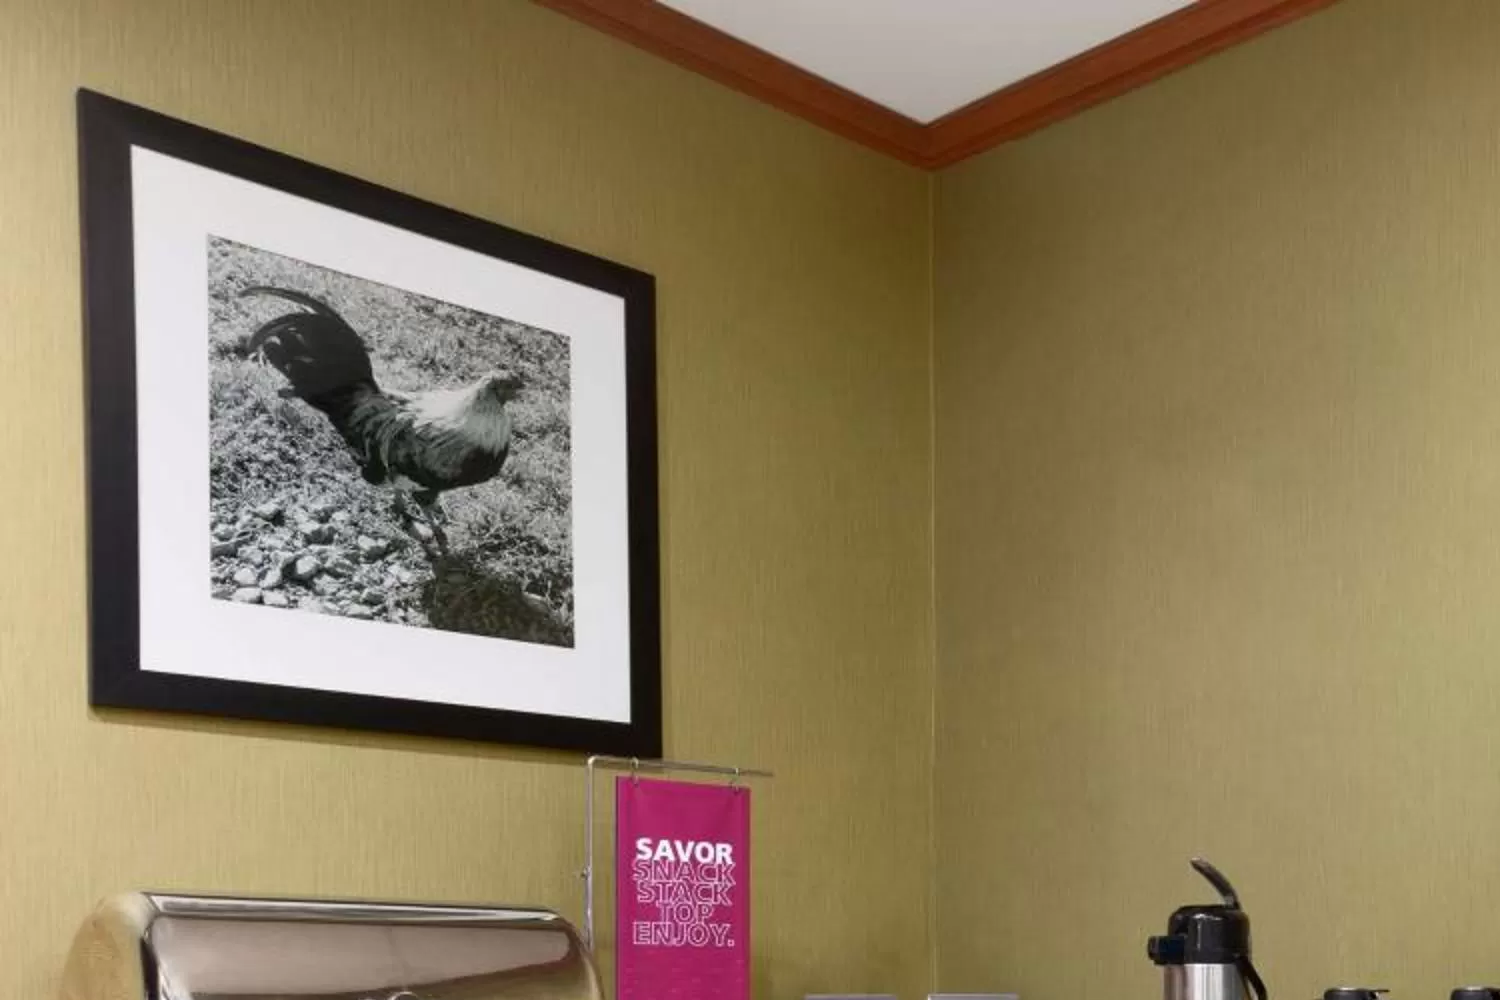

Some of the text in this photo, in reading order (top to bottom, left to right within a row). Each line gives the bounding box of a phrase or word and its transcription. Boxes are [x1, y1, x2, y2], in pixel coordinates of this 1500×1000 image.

[636, 838, 733, 865] SAVOR
[633, 860, 736, 885] SNACK
[637, 880, 732, 906] STACK
[656, 901, 714, 925] TOP
[633, 921, 735, 947] ENJOY.
